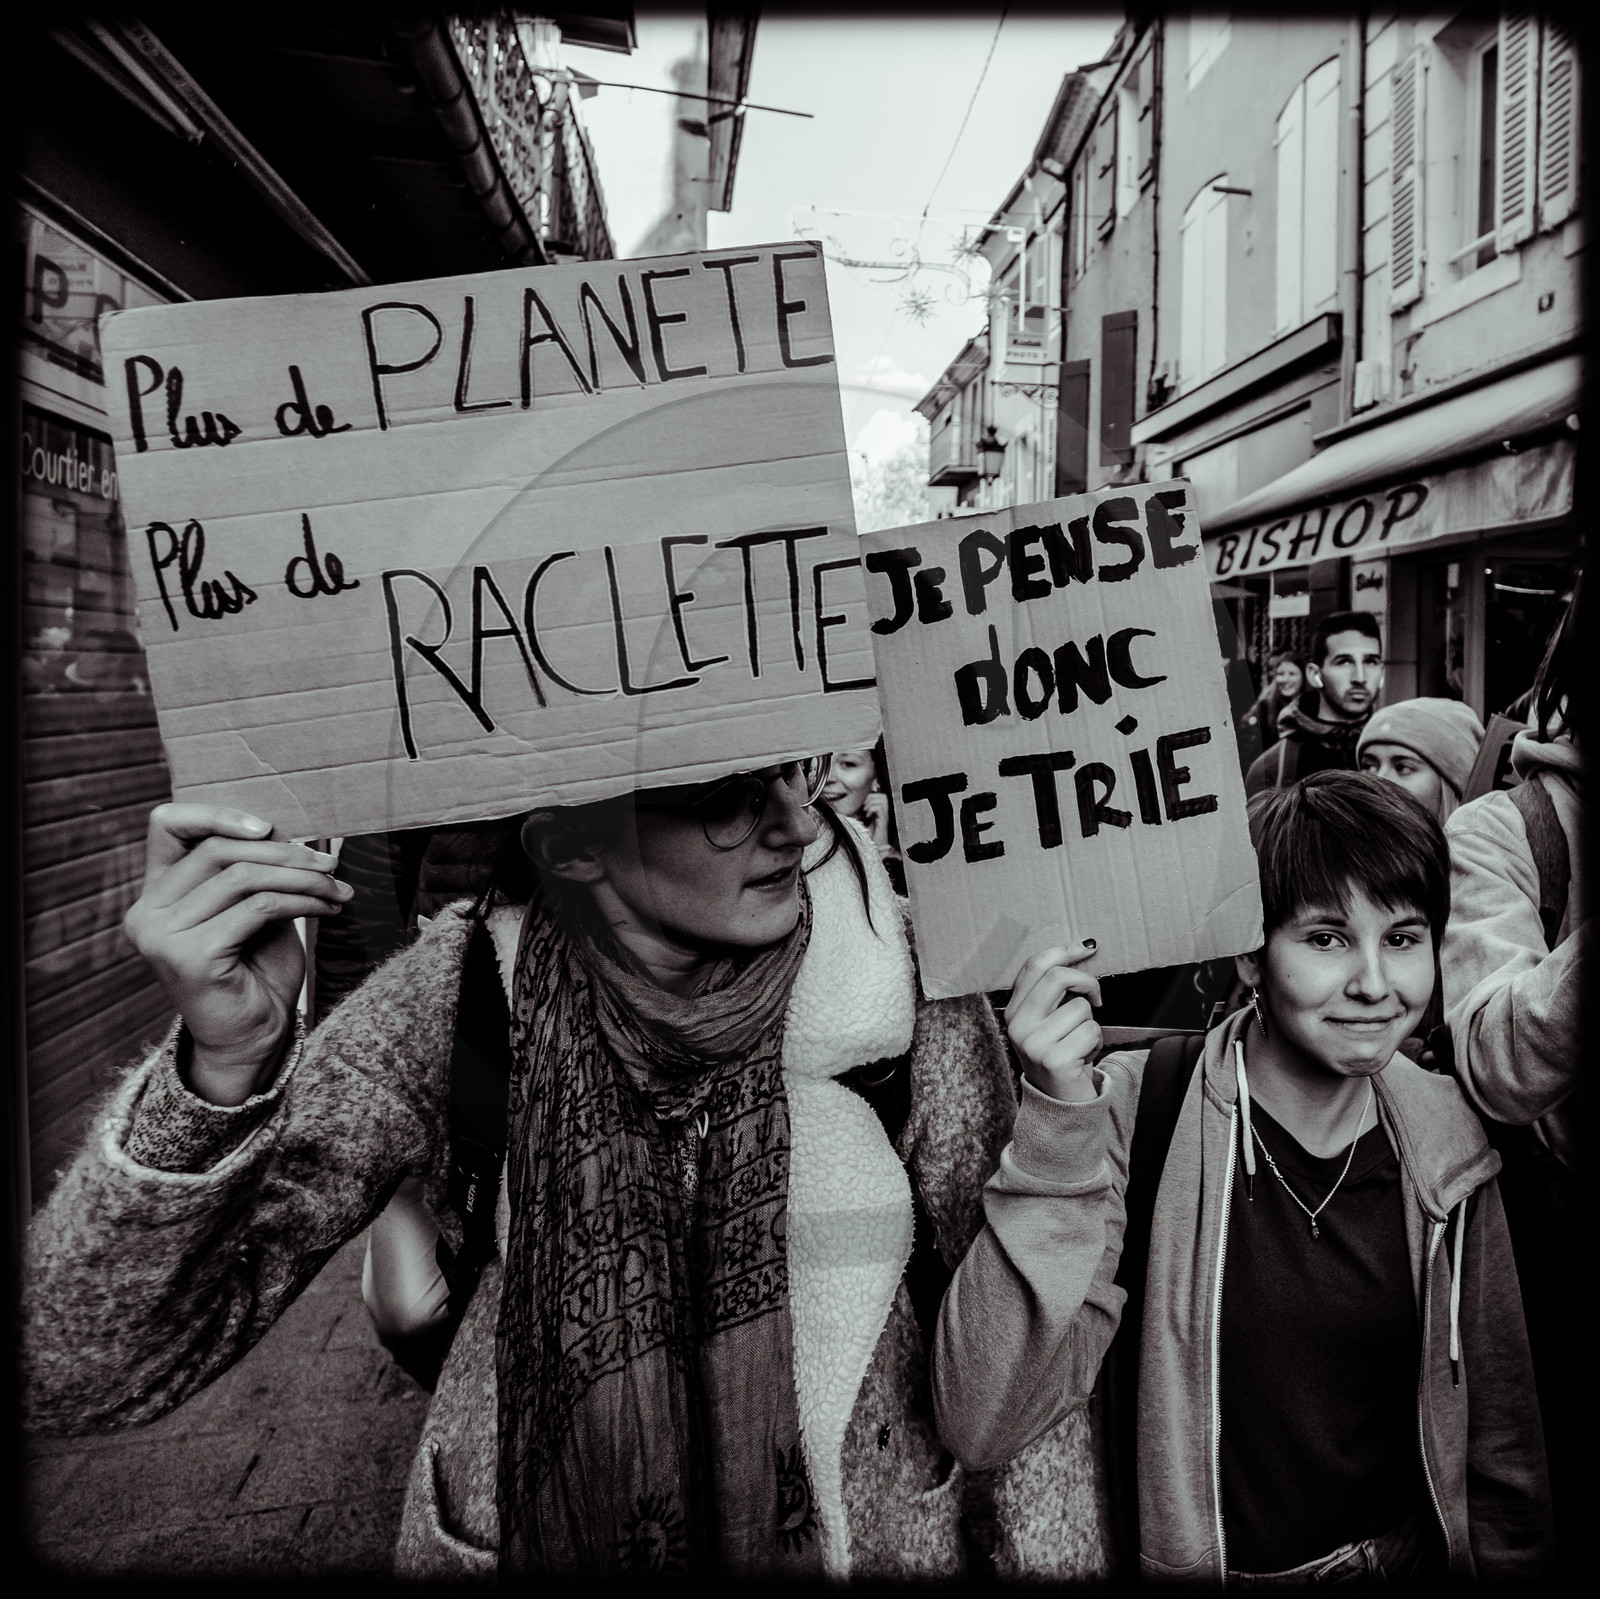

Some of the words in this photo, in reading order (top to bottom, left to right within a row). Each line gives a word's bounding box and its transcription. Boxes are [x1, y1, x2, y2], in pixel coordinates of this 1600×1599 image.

[125, 355, 242, 453] Plus
[275, 365, 352, 438] de
[362, 252, 835, 431] PLANETE
[865, 547, 954, 635] JE
[958, 489, 1200, 617] PENSE
[1215, 482, 1430, 576] BISHOP
[146, 519, 258, 631] Plus
[285, 513, 360, 598] de
[381, 526, 877, 761] RACLETTE
[901, 772, 1006, 864] JE
